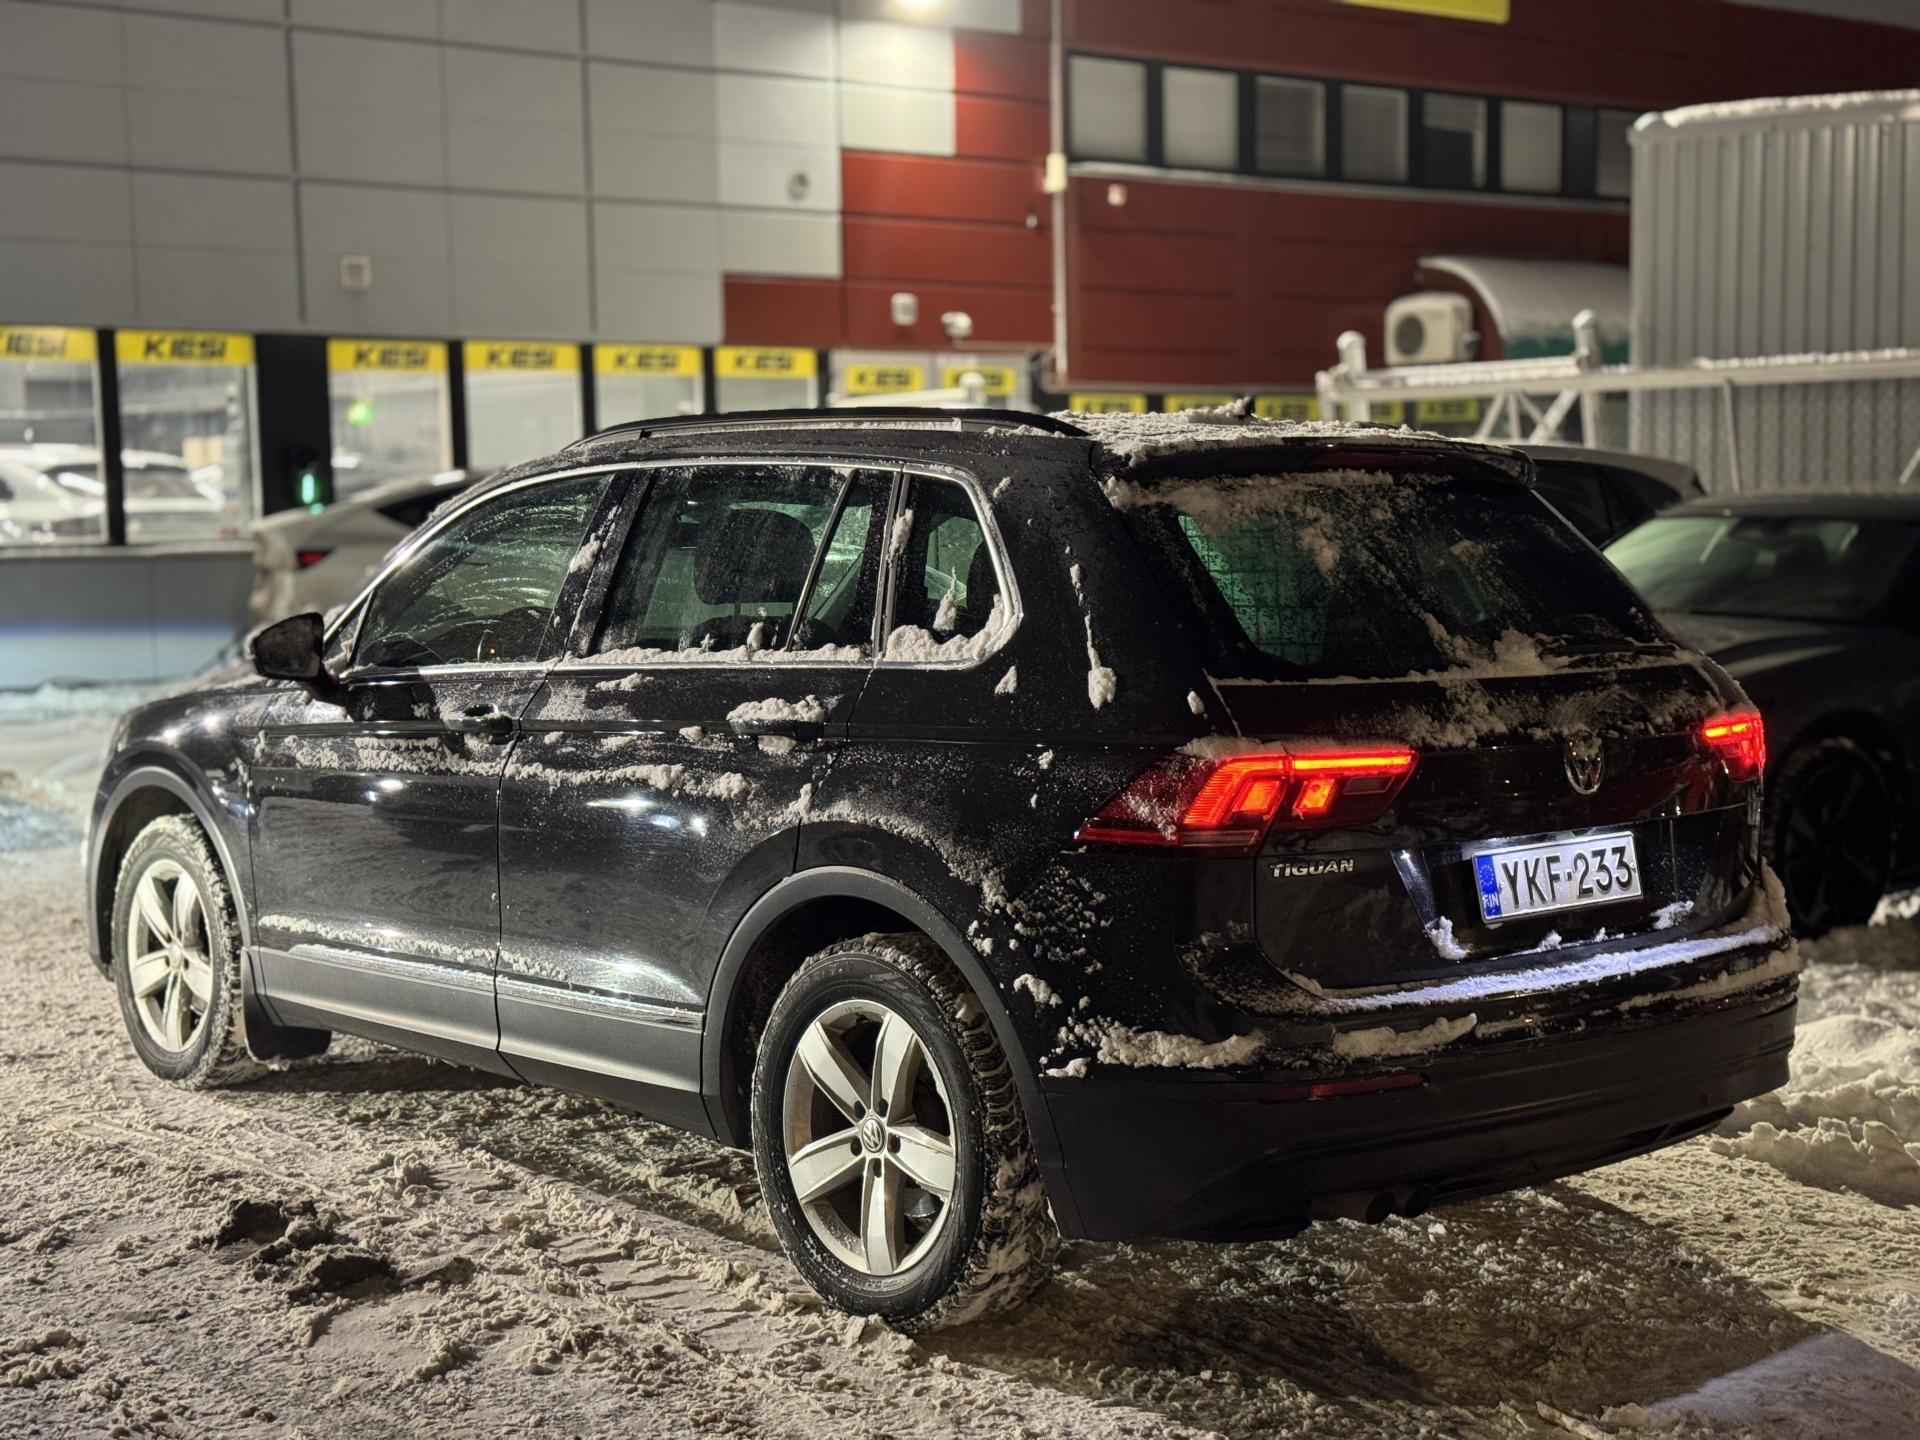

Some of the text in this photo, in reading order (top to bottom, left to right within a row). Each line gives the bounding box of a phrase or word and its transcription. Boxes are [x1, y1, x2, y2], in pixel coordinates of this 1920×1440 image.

[1270, 859, 1354, 878] TIGUAN
[1501, 846, 1633, 909] YKF-233
[1481, 893, 1500, 908] FIN
